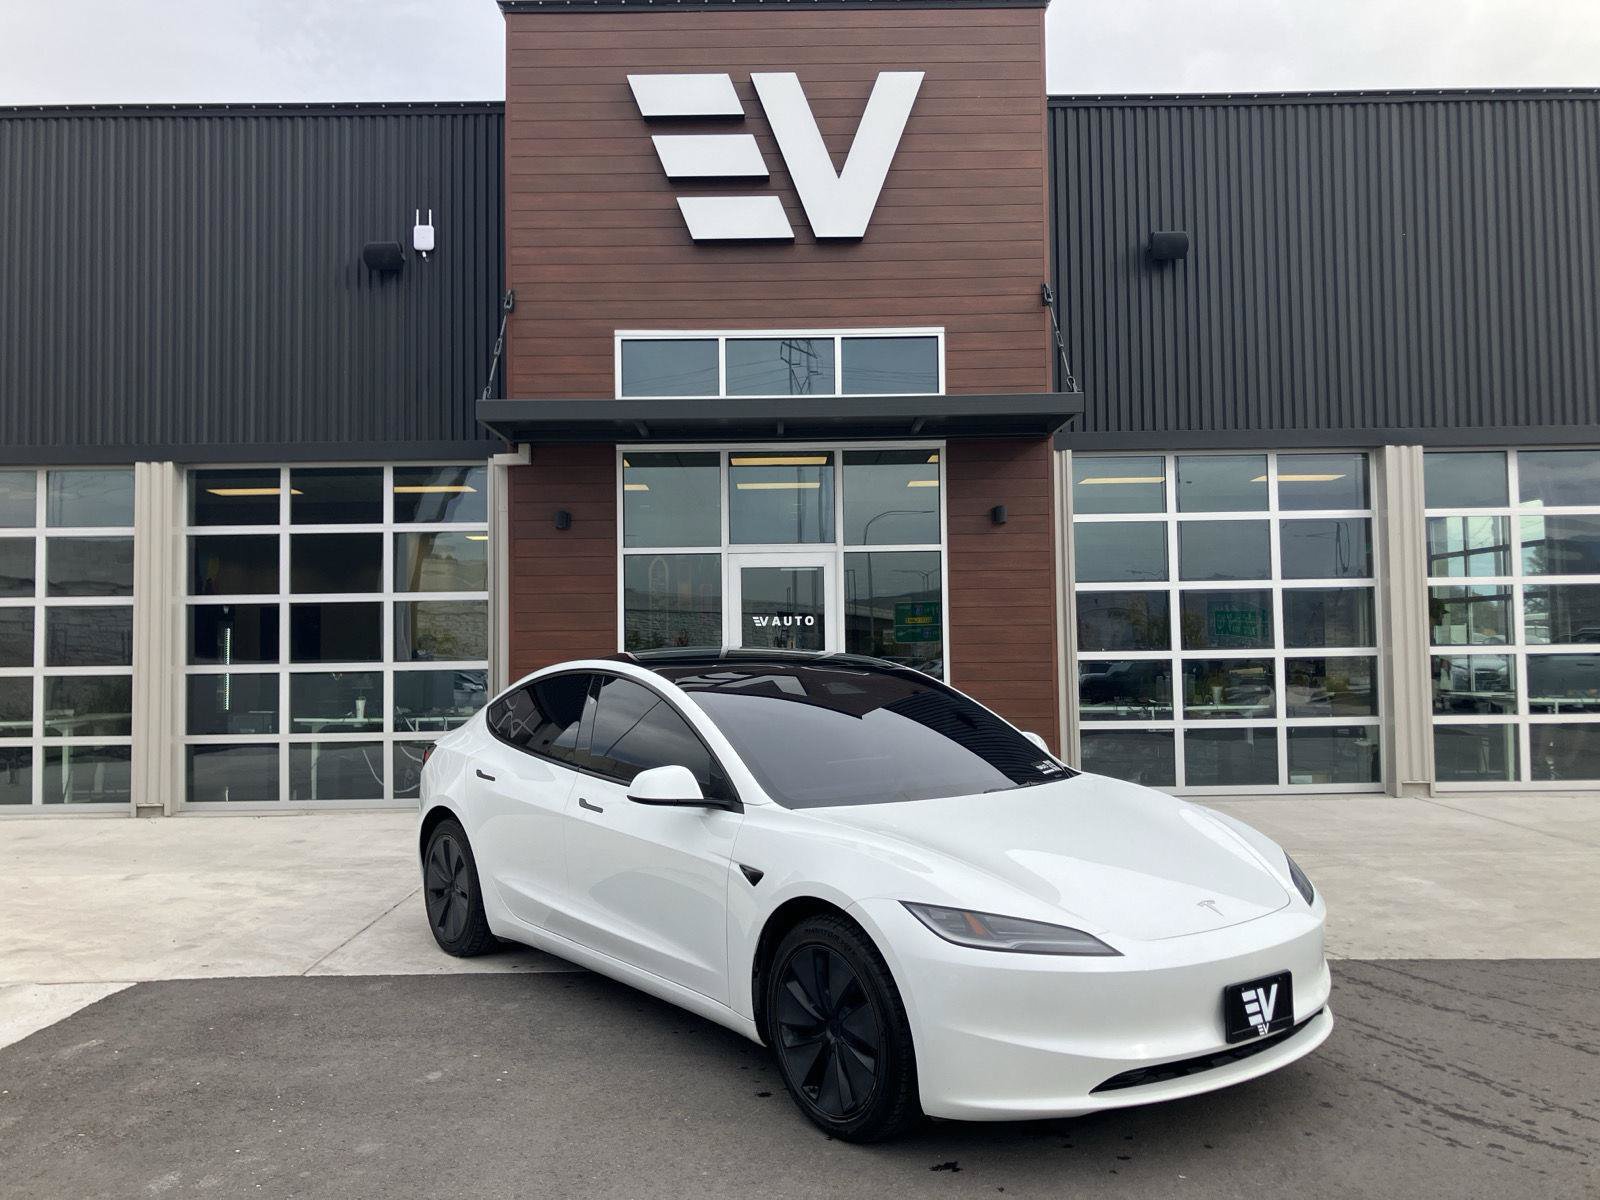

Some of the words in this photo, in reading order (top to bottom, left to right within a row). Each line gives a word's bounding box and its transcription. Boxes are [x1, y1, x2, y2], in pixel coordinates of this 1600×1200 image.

[627, 71, 926, 240] EV
[1241, 983, 1278, 1026] EV
[1257, 1022, 1270, 1036] EV
